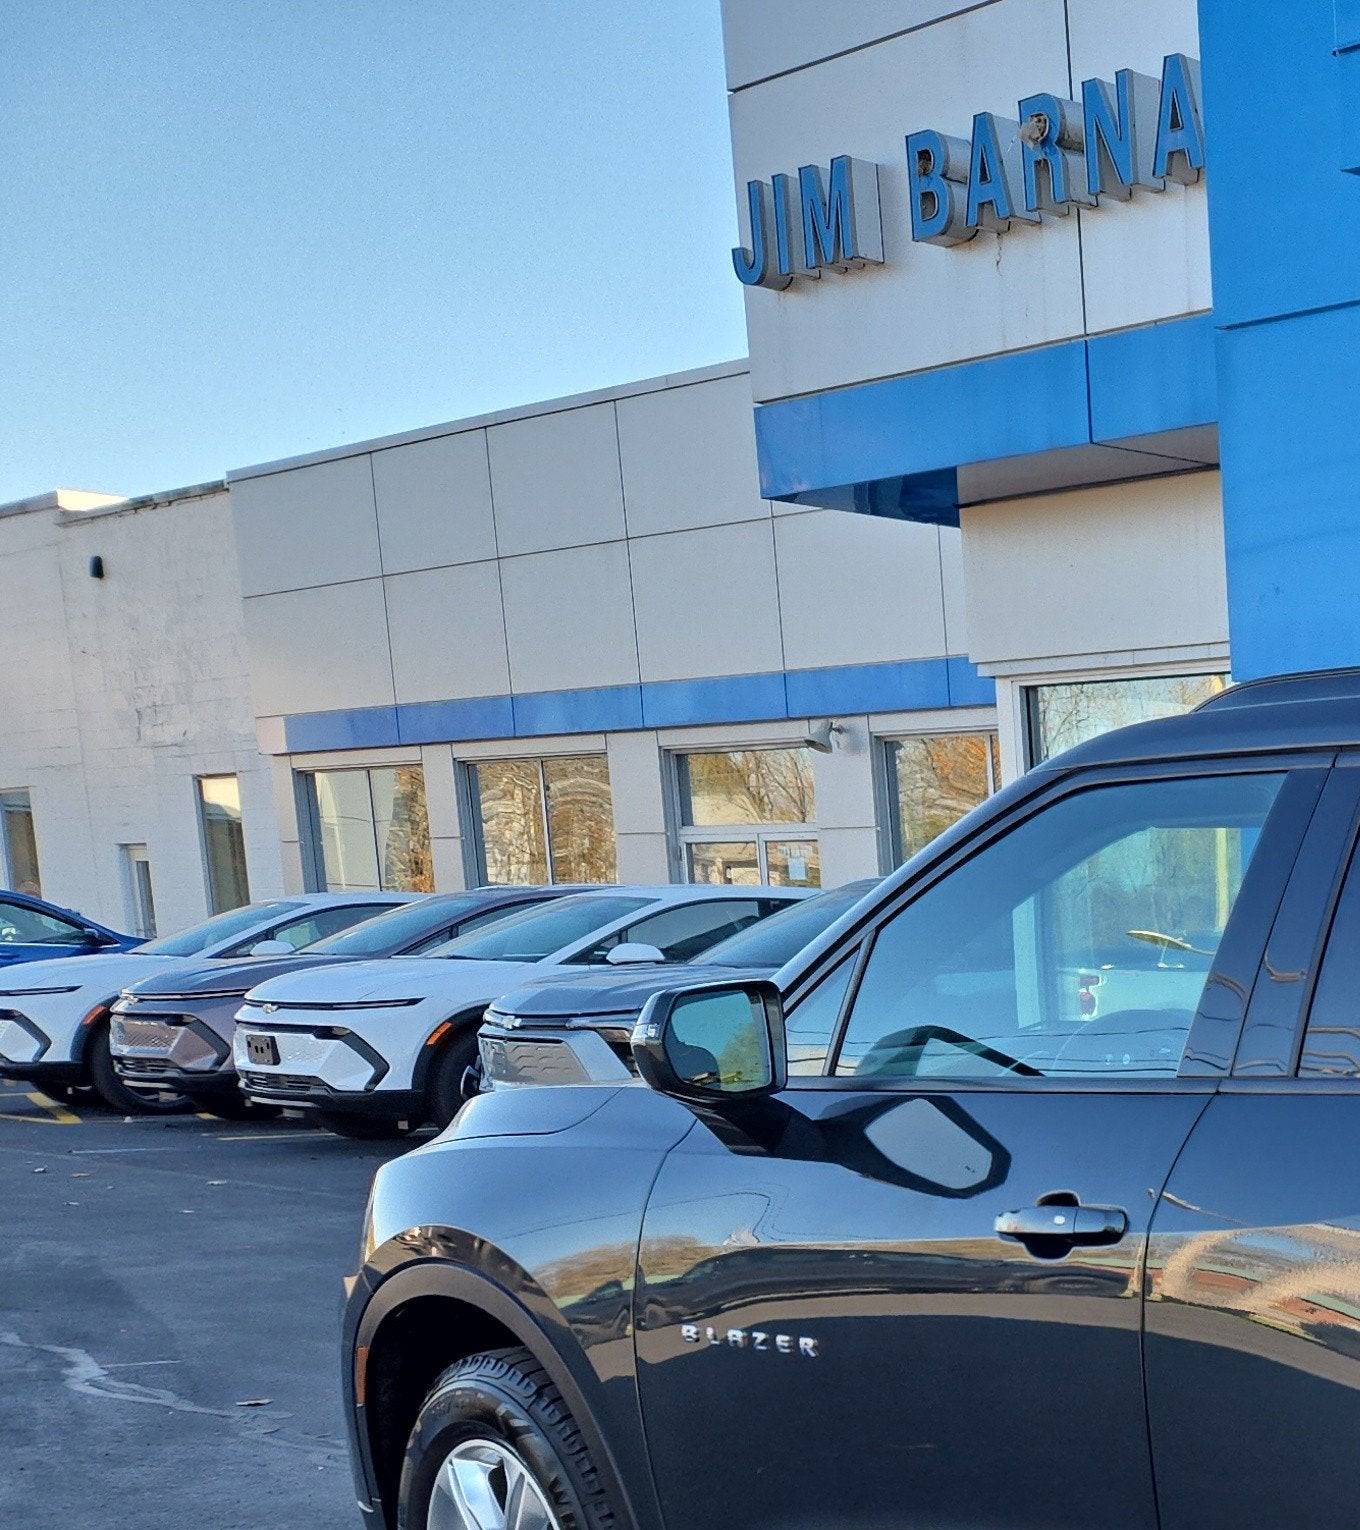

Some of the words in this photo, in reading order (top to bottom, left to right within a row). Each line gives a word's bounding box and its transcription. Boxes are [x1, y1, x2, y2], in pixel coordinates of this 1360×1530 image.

[731, 154, 874, 290] JIM
[904, 53, 1205, 247] BARNA
[680, 1323, 819, 1358] BLAZER
